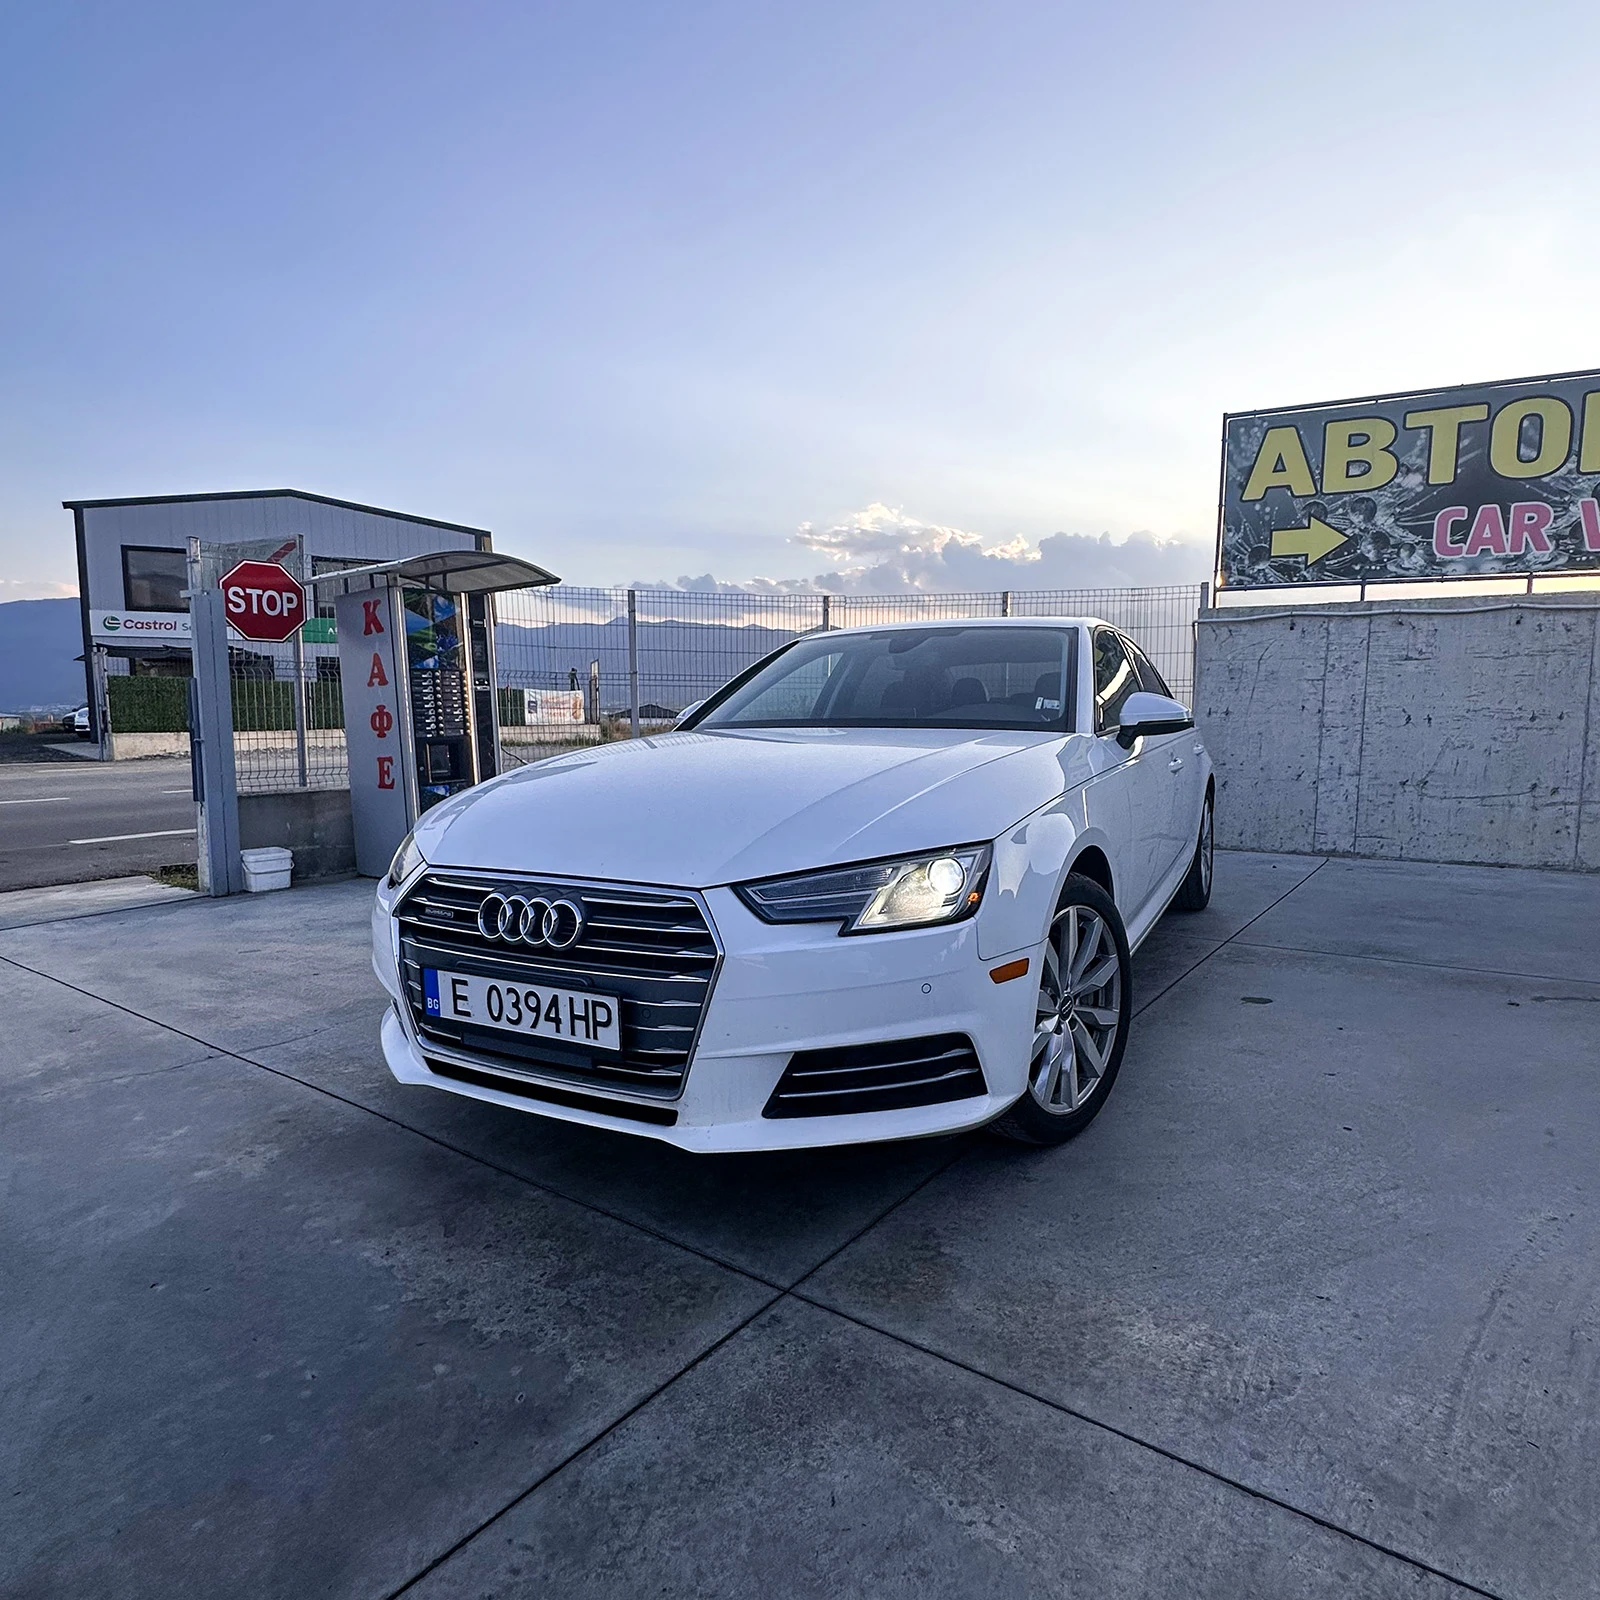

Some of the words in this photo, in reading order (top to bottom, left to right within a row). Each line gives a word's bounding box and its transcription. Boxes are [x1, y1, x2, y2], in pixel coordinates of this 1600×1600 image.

[1433, 500, 1554, 558] CAR
[227, 586, 298, 617] STOP
[123, 619, 177, 632] Castrol
[362, 599, 396, 790] КАФЕ
[427, 997, 439, 1010] BG
[451, 976, 472, 1018] E
